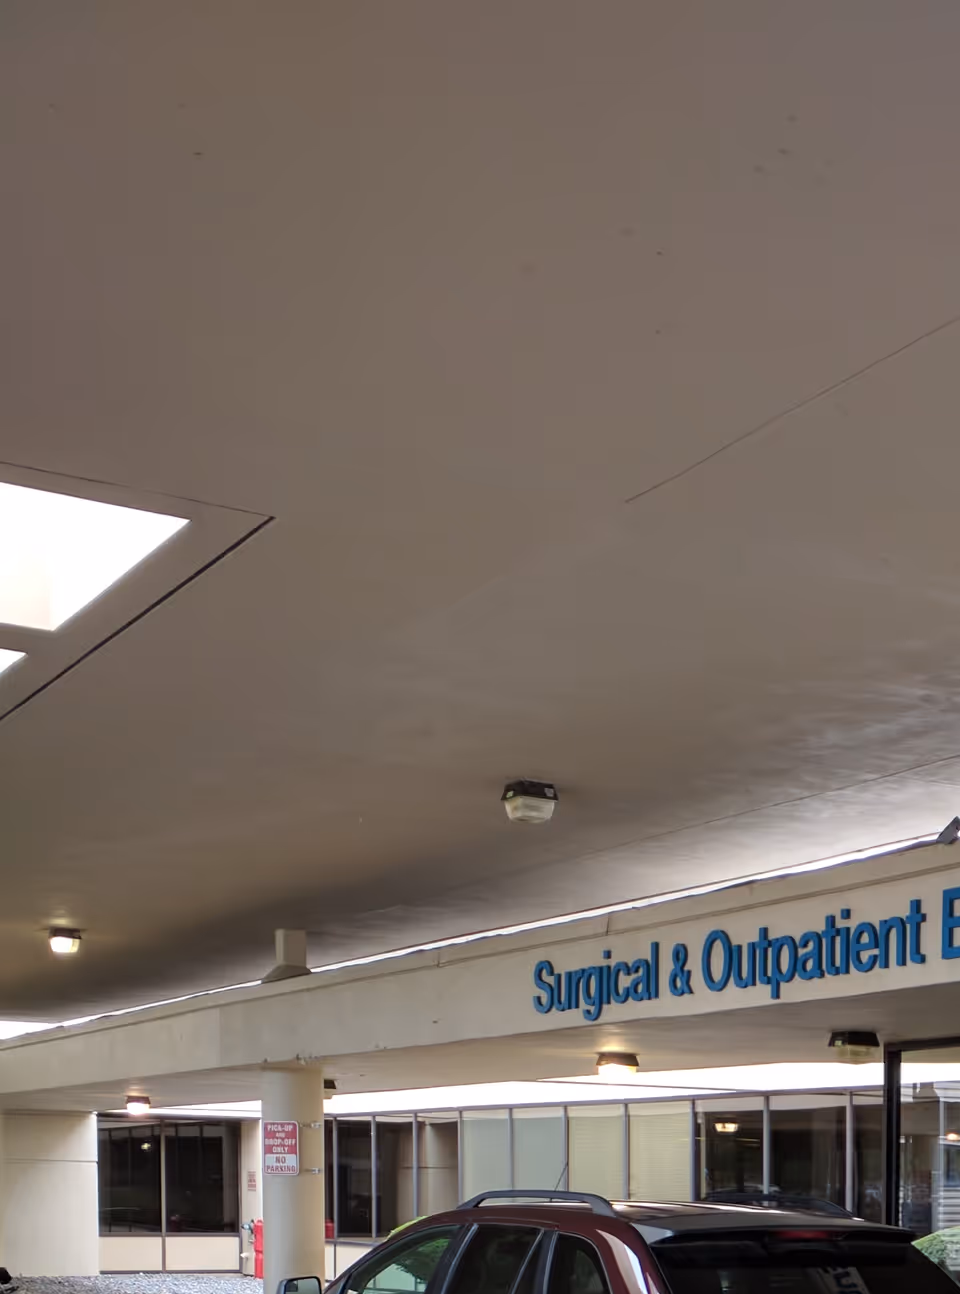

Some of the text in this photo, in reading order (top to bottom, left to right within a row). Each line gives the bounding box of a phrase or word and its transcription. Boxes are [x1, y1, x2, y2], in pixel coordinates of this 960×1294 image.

[533, 942, 659, 1021] Surgical
[668, 943, 694, 996] &
[701, 908, 926, 999] Outpatient
